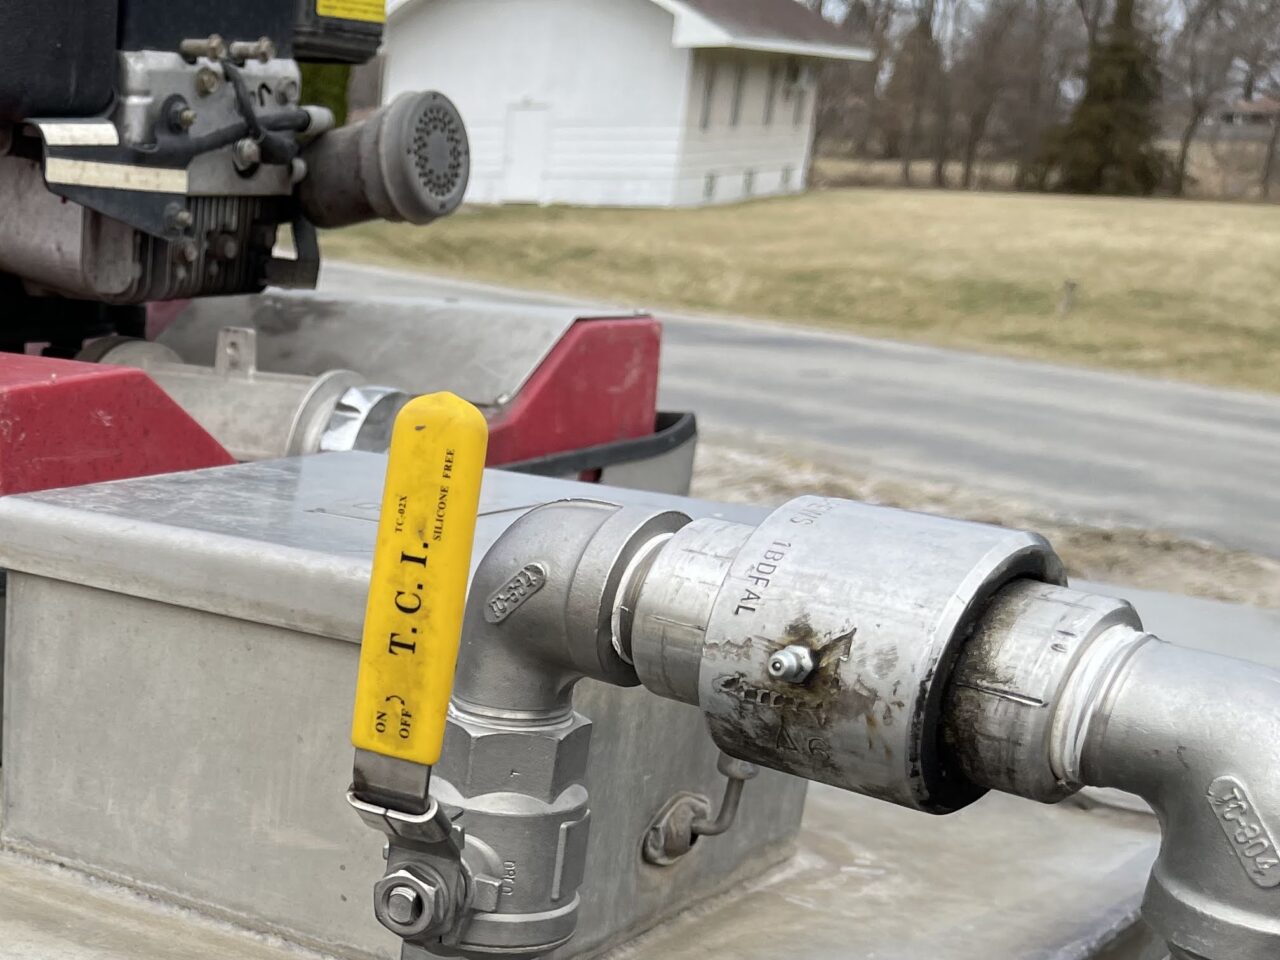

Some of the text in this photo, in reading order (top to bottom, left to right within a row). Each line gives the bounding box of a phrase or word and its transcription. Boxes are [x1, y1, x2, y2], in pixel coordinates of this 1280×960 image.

[432, 448, 455, 541] SILICONE FREE
[375, 710, 387, 733] ON
[399, 708, 412, 739] OFF
